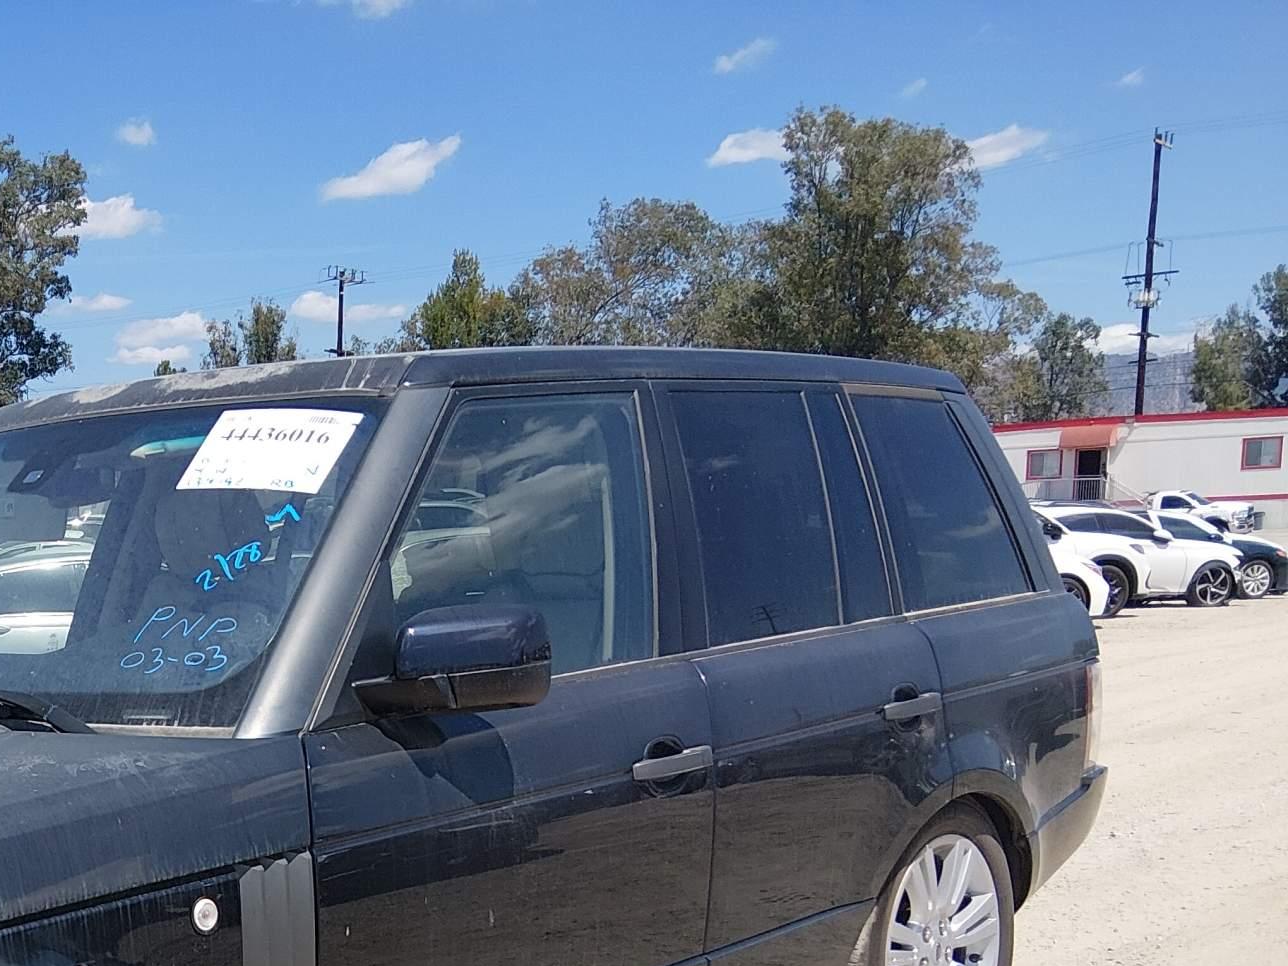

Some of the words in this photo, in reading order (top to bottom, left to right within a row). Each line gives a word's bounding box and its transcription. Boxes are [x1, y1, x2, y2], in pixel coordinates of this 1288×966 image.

[220, 426, 330, 445] 44436016
[133, 606, 238, 644] PNP
[120, 645, 228, 674] 03-03
